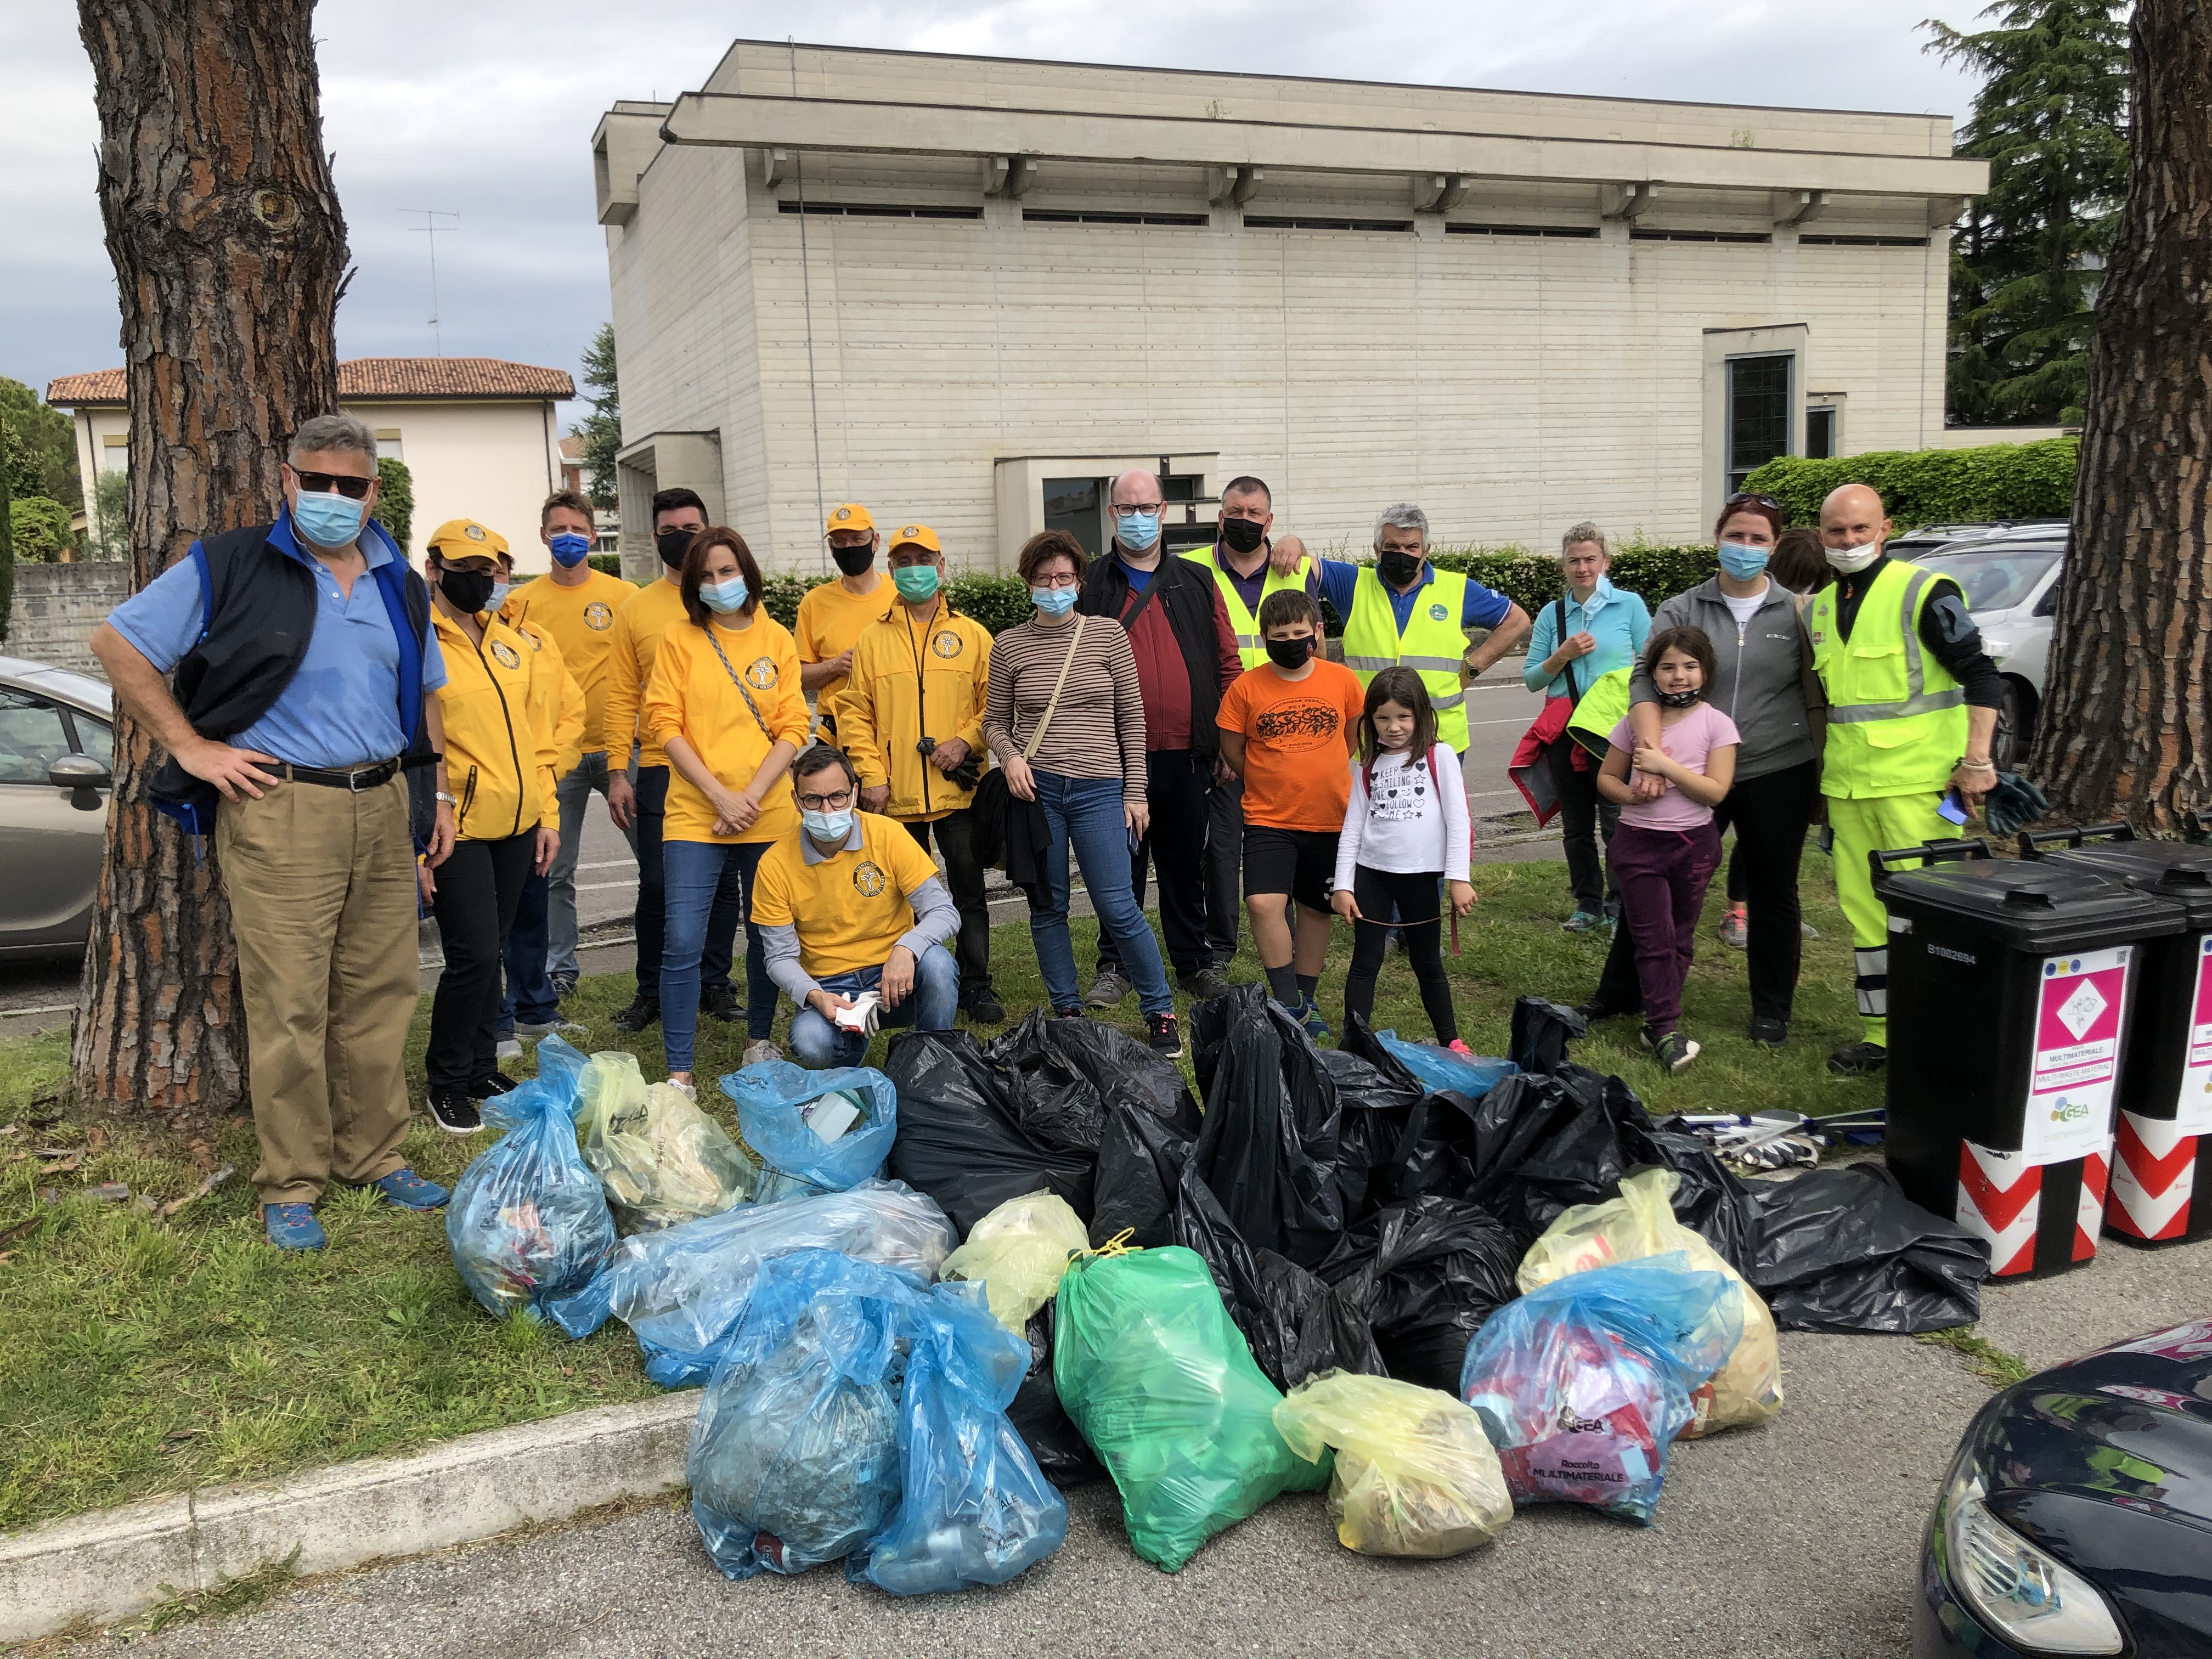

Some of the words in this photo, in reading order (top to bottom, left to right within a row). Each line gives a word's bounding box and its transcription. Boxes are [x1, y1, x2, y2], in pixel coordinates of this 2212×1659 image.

[1380, 766, 1398, 779] KEEP
[1380, 775, 1410, 788] SMILING
[1386, 799, 1412, 809] FOLLOW
[1389, 810, 1400, 819] ME
[2050, 1046, 2104, 1063] MULTIMATERIALE
[2064, 1104, 2089, 1120] GEA
[1561, 1459, 1600, 1470] Raccolta
[1533, 1468, 1624, 1482] MULTIMATERIALE
